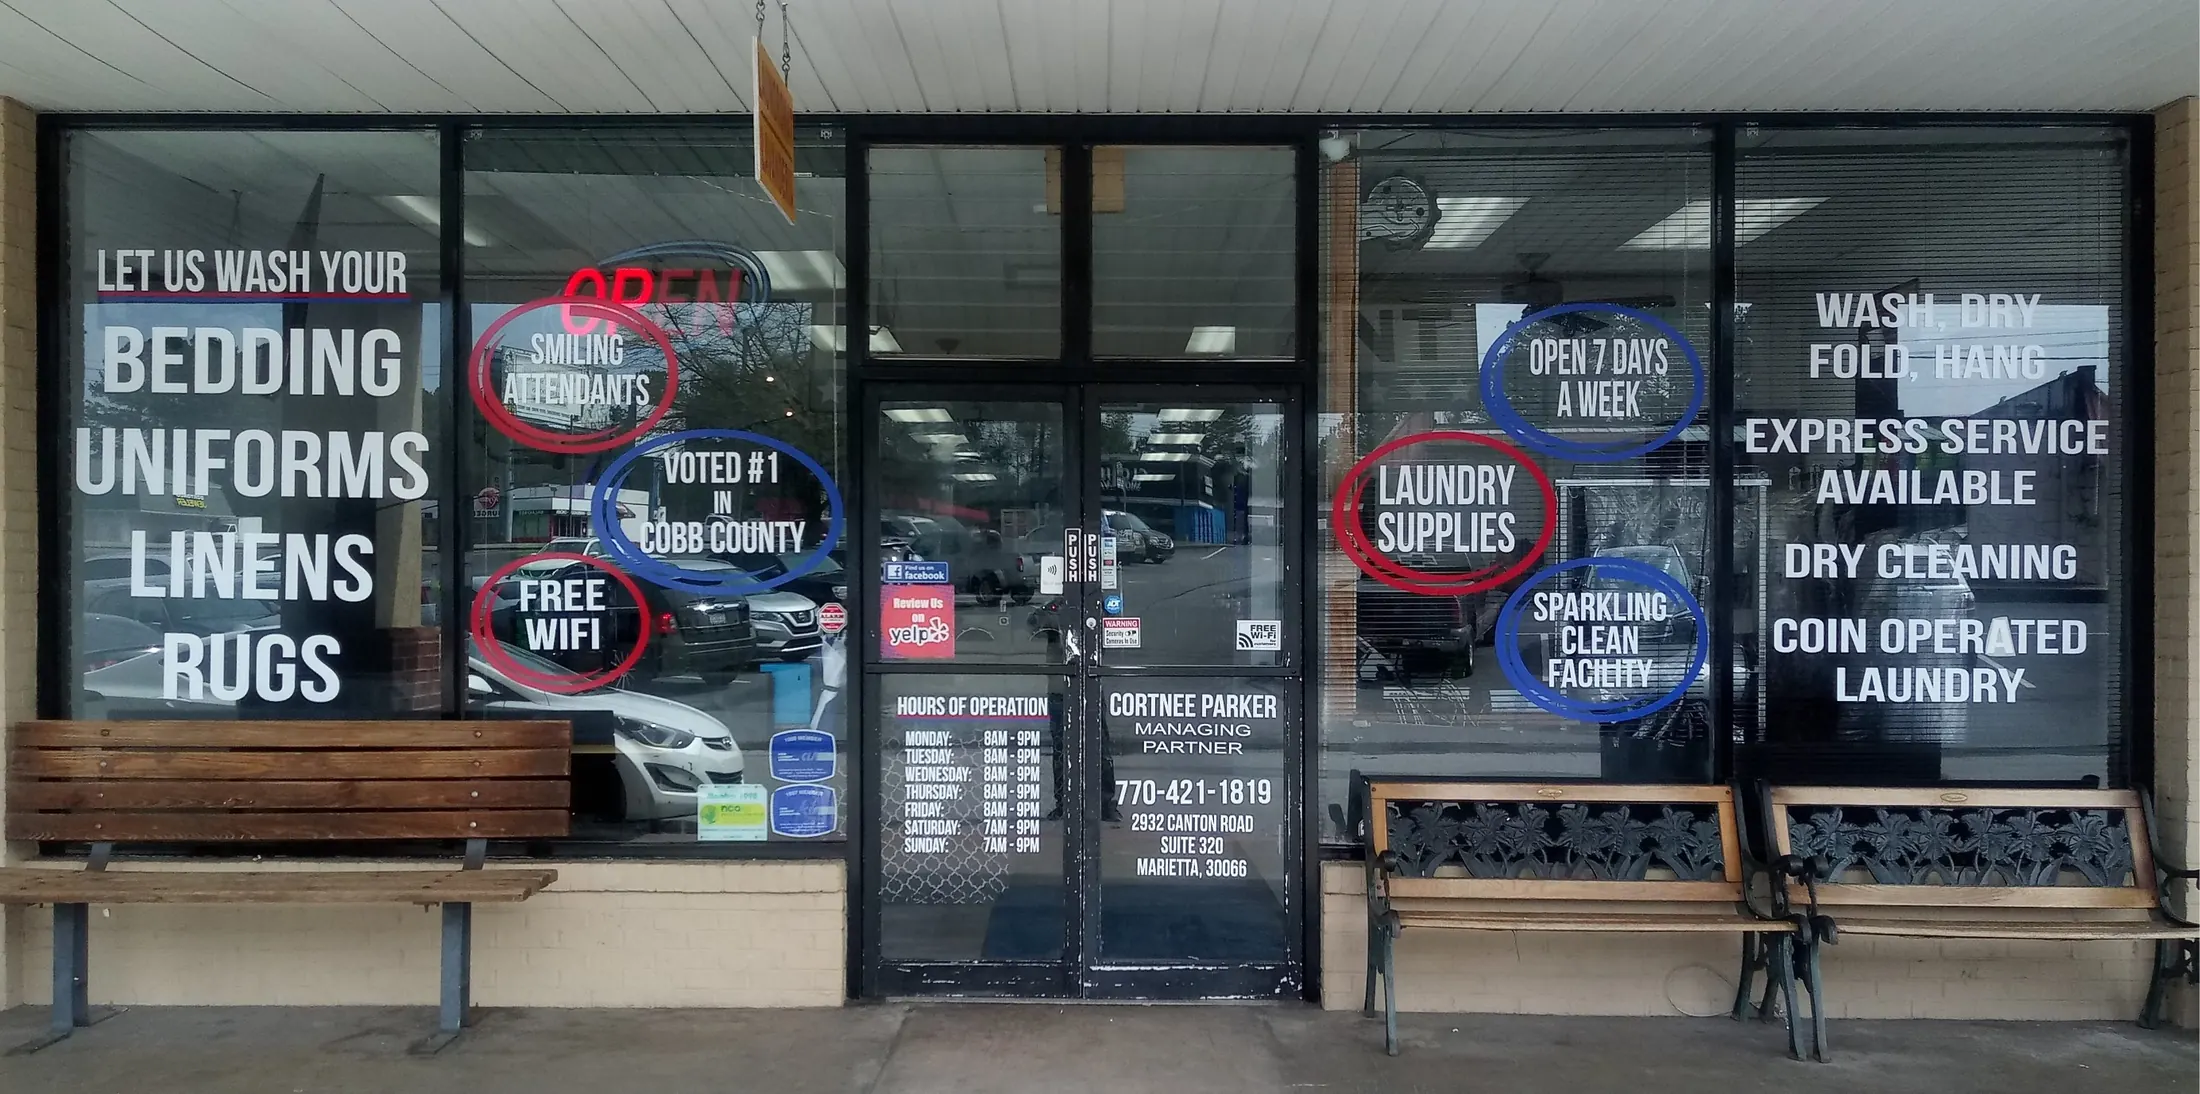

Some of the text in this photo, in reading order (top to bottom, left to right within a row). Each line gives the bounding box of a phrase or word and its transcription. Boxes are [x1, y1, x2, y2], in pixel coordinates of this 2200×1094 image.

[98, 248, 407, 294] LET US WASH YOUR
[560, 267, 746, 337] OPEN
[1815, 292, 2041, 332] WASH, DRY
[104, 326, 402, 397] BEDDING
[531, 333, 624, 366] SMILING
[1529, 338, 1669, 376] OPEN 7 DAYS
[1809, 343, 2046, 381] FOLD, HANG
[503, 373, 650, 406] ATTENDANTS
[1557, 380, 1641, 418] A WEEK
[1745, 418, 2109, 455] EXPRESS SERVICE
[75, 427, 431, 500] UNIFORMS
[664, 451, 779, 485] VOTED #1
[1379, 465, 1516, 506] LAUNDRY
[1816, 469, 2037, 505] AVAILABLE
[713, 490, 732, 515] IN
[639, 521, 806, 554] COBB COUNTY
[1378, 512, 1516, 553] SUPPLIES
[130, 530, 375, 602] LINENS
[1068, 534, 1078, 582] PUSH
[1088, 534, 1097, 582] PUSH
[1785, 543, 2078, 580] DRY CLEANING
[905, 571, 945, 580] facebook
[520, 579, 606, 612] FREE
[893, 598, 943, 608] Review Us
[1533, 592, 1667, 621] SPARKLING
[525, 618, 600, 651] WIFI
[912, 613, 925, 623] on
[889, 624, 930, 646] yelp
[1562, 626, 1639, 655] CLEAN
[1773, 617, 2087, 656] COIN OPERATED
[163, 632, 342, 703] RUGS
[1549, 659, 1653, 688] FACILITY
[1836, 667, 2025, 703] LAUNDRY
[897, 696, 1049, 717] HOURS OF OPERATION
[1109, 692, 1277, 719] CORTNEE PARKER
[905, 731, 953, 747] MONDAY:
[983, 731, 1008, 747] 8AM
[1016, 731, 1040, 747] 9PM
[1135, 723, 1252, 738] MANAGING
[905, 749, 955, 765] TUESDAY:
[983, 749, 1008, 765] 8AM
[1016, 749, 1040, 765] 9PM
[1143, 741, 1244, 755] PARTNER
[905, 766, 972, 782] WEDNESDAY:
[983, 766, 1008, 782] 8AM
[1016, 766, 1040, 782] 9PM
[905, 784, 963, 800] THURSDAY:
[983, 784, 1008, 800] 8AM
[1016, 784, 1040, 800] 9PM
[1116, 779, 1272, 806] 770-421-1819
[905, 802, 945, 818] FRIDAY:
[983, 802, 1008, 818] 8AM
[1016, 802, 1040, 818] 9PM
[1131, 814, 1254, 831] 2932 CANTON ROAD
[905, 820, 962, 836] SATURDAY:
[983, 820, 1008, 836] 7AM
[1016, 820, 1040, 836] 9PM
[905, 837, 949, 853] SUNDAY:
[983, 837, 1008, 853] 7AM
[1016, 837, 1040, 853] 9PM
[1160, 836, 1224, 854] SUITE 320
[1137, 859, 1247, 879] MARIETTA, 30066
